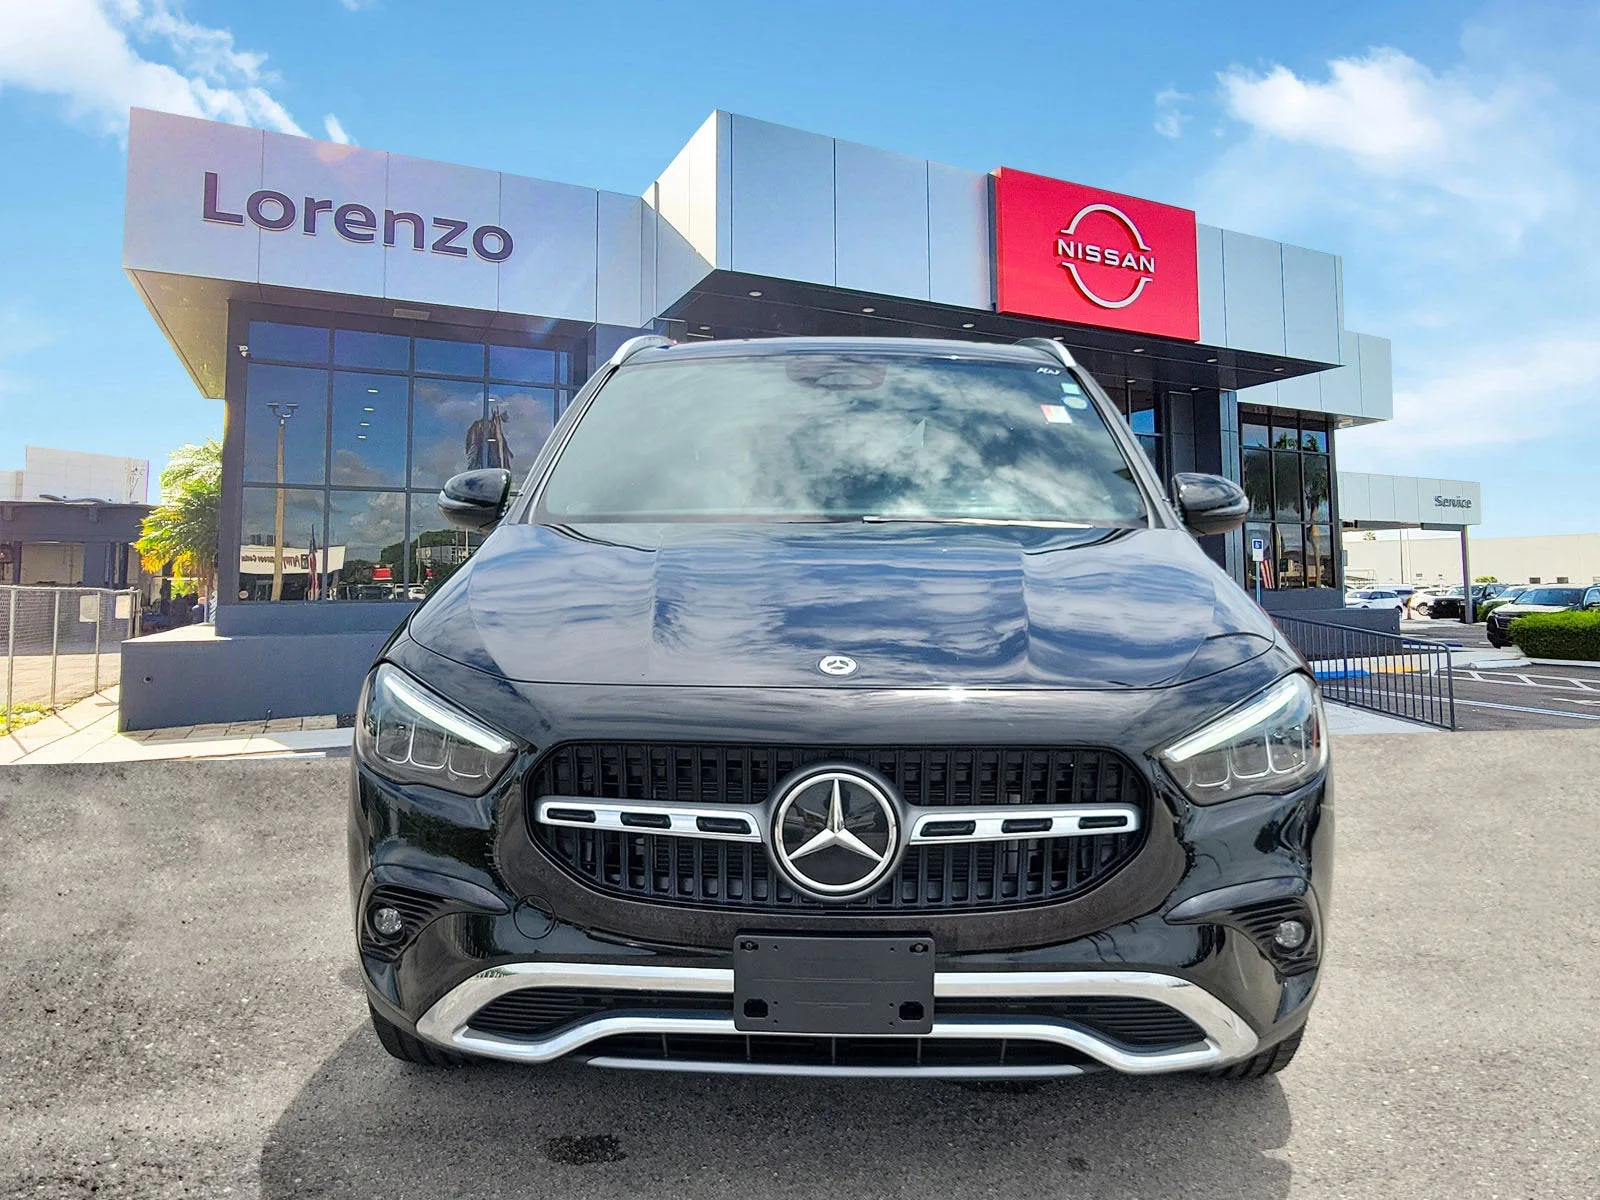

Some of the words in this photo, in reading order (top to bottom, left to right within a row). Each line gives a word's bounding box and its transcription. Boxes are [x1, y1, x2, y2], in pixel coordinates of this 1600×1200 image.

[203, 171, 514, 262] Lorenzo
[1056, 238, 1155, 273] NISSAN
[1434, 495, 1472, 509] Service
